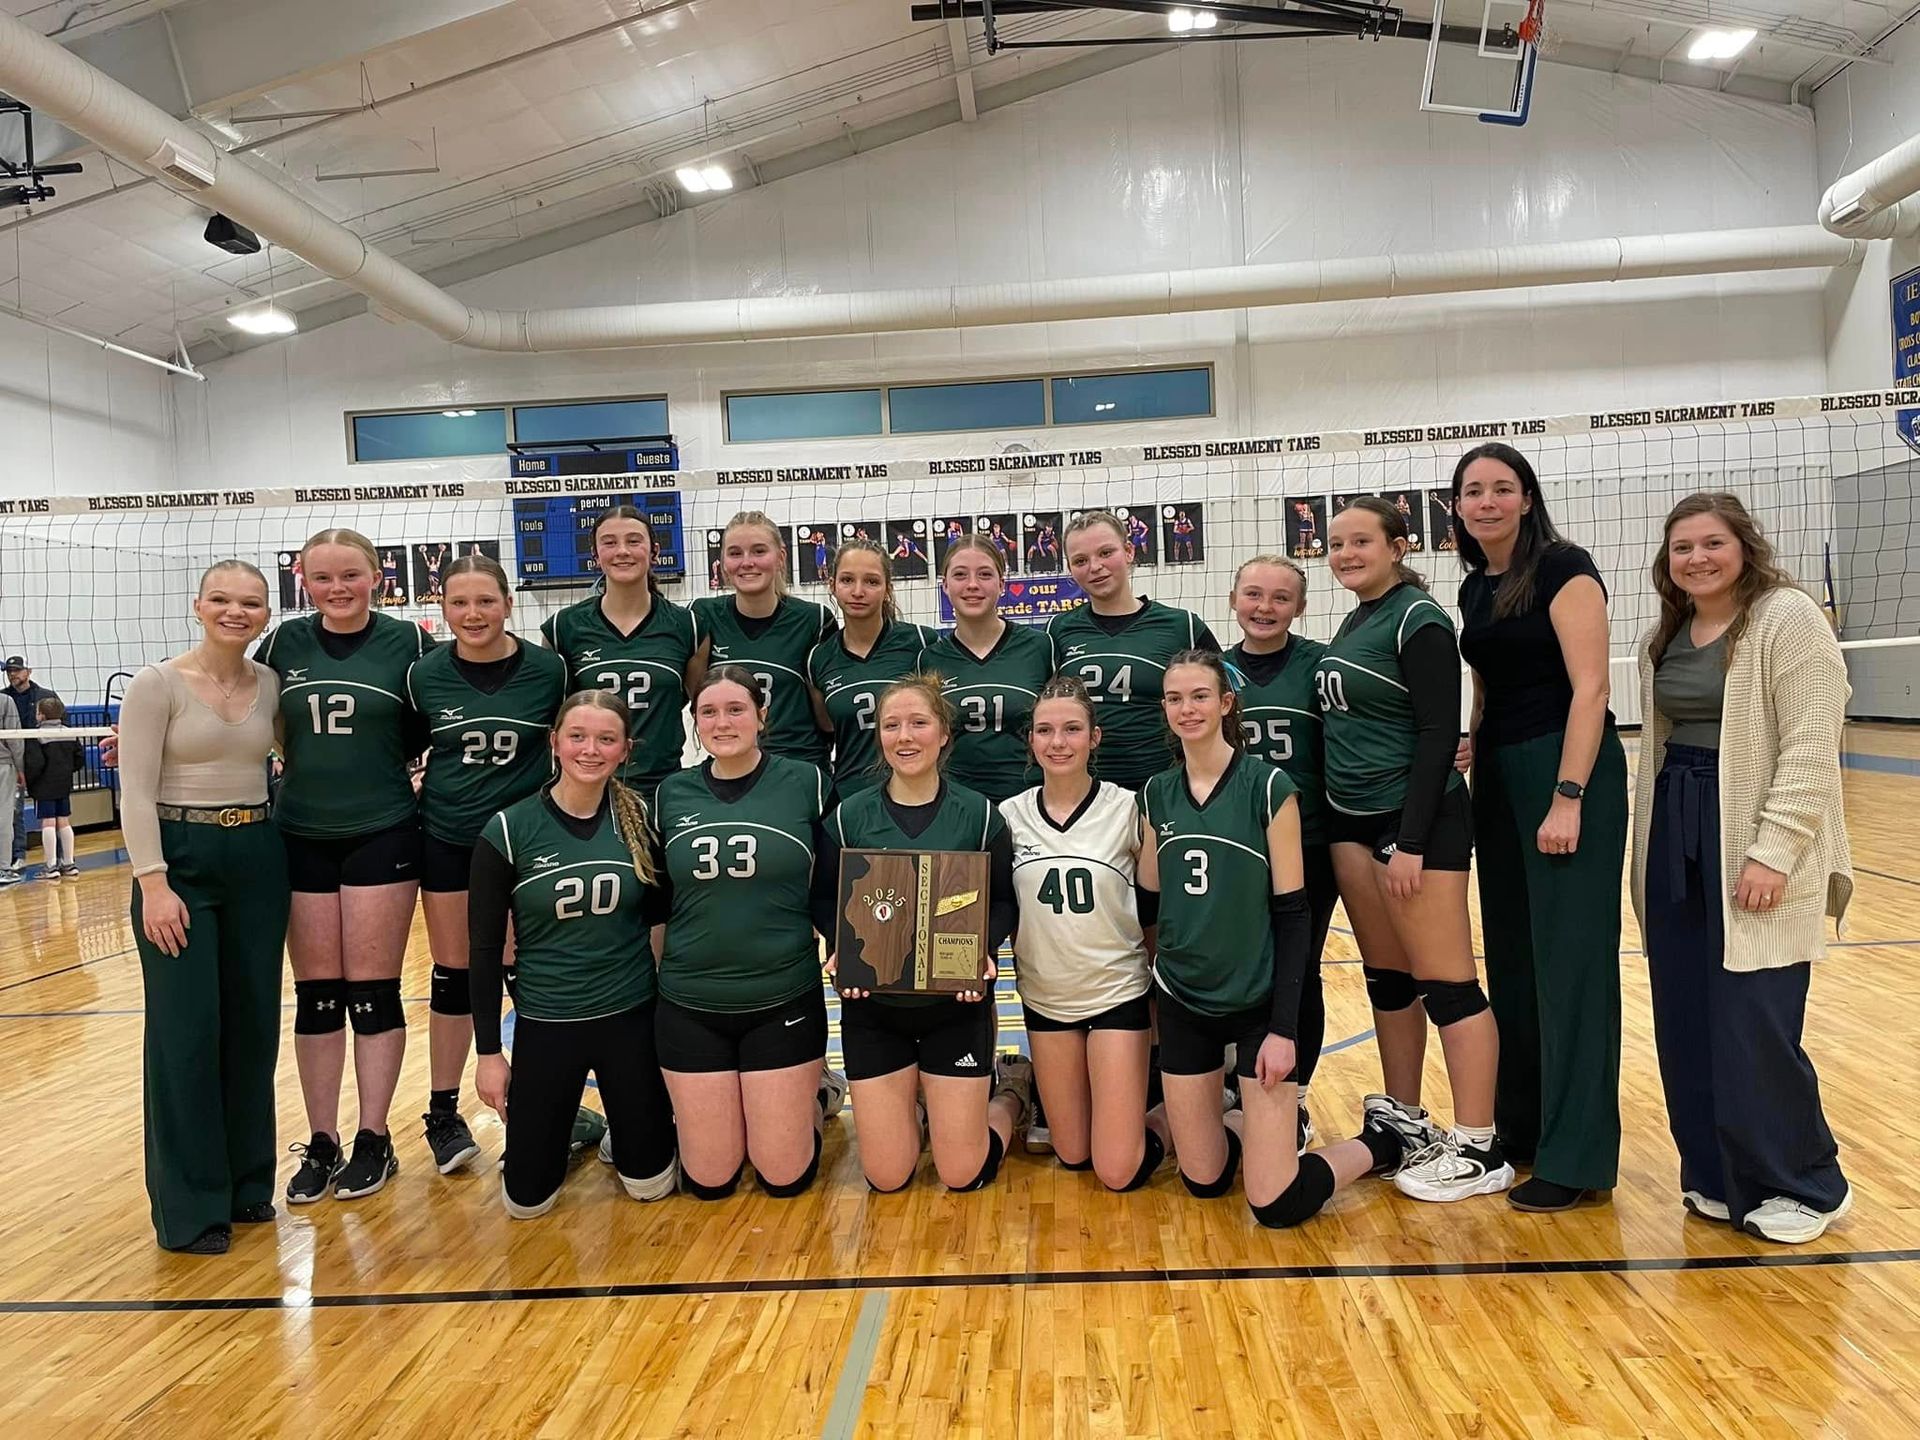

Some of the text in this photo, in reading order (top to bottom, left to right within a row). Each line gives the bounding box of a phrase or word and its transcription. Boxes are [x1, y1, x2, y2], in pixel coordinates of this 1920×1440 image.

[1820, 393, 1881, 411] BLESSED
[1589, 402, 1775, 429] BLESSED SACRAMENT TARS
[1363, 419, 1546, 446] BLESSED SACRAMENT TARS
[636, 453, 670, 466] Guests
[1143, 436, 1321, 461] BLESSED SACRAMENT TARS
[518, 459, 546, 472] Home
[716, 464, 888, 485] BLESSED SACRAMENT TARS
[928, 451, 1102, 475] BLESSED SACRAMENT TARS
[295, 483, 464, 503] BLESSED SACRAMENT TARS
[504, 474, 676, 494] BLESSED SACRAMENT TARS
[18, 499, 50, 513] TARS
[88, 491, 255, 511] BLESSED SACRAMENT TARS
[580, 496, 610, 511] period
[525, 562, 544, 572] won
[1029, 584, 1057, 595] our
[997, 602, 1033, 615] rade
[597, 671, 652, 709] 22
[1079, 664, 1133, 702] 24
[1315, 669, 1350, 712] 30
[307, 693, 356, 735] 12
[960, 694, 1004, 732] 31
[461, 730, 520, 766] 29
[1245, 719, 1294, 761] 25
[691, 834, 758, 880] 33
[1183, 849, 1209, 896] 3
[554, 872, 621, 921] 20
[862, 888, 907, 907] 2025
[1036, 867, 1096, 915] 40
[916, 862, 929, 983] SECTIONAL
[938, 937, 974, 946] CHAMPIONS
